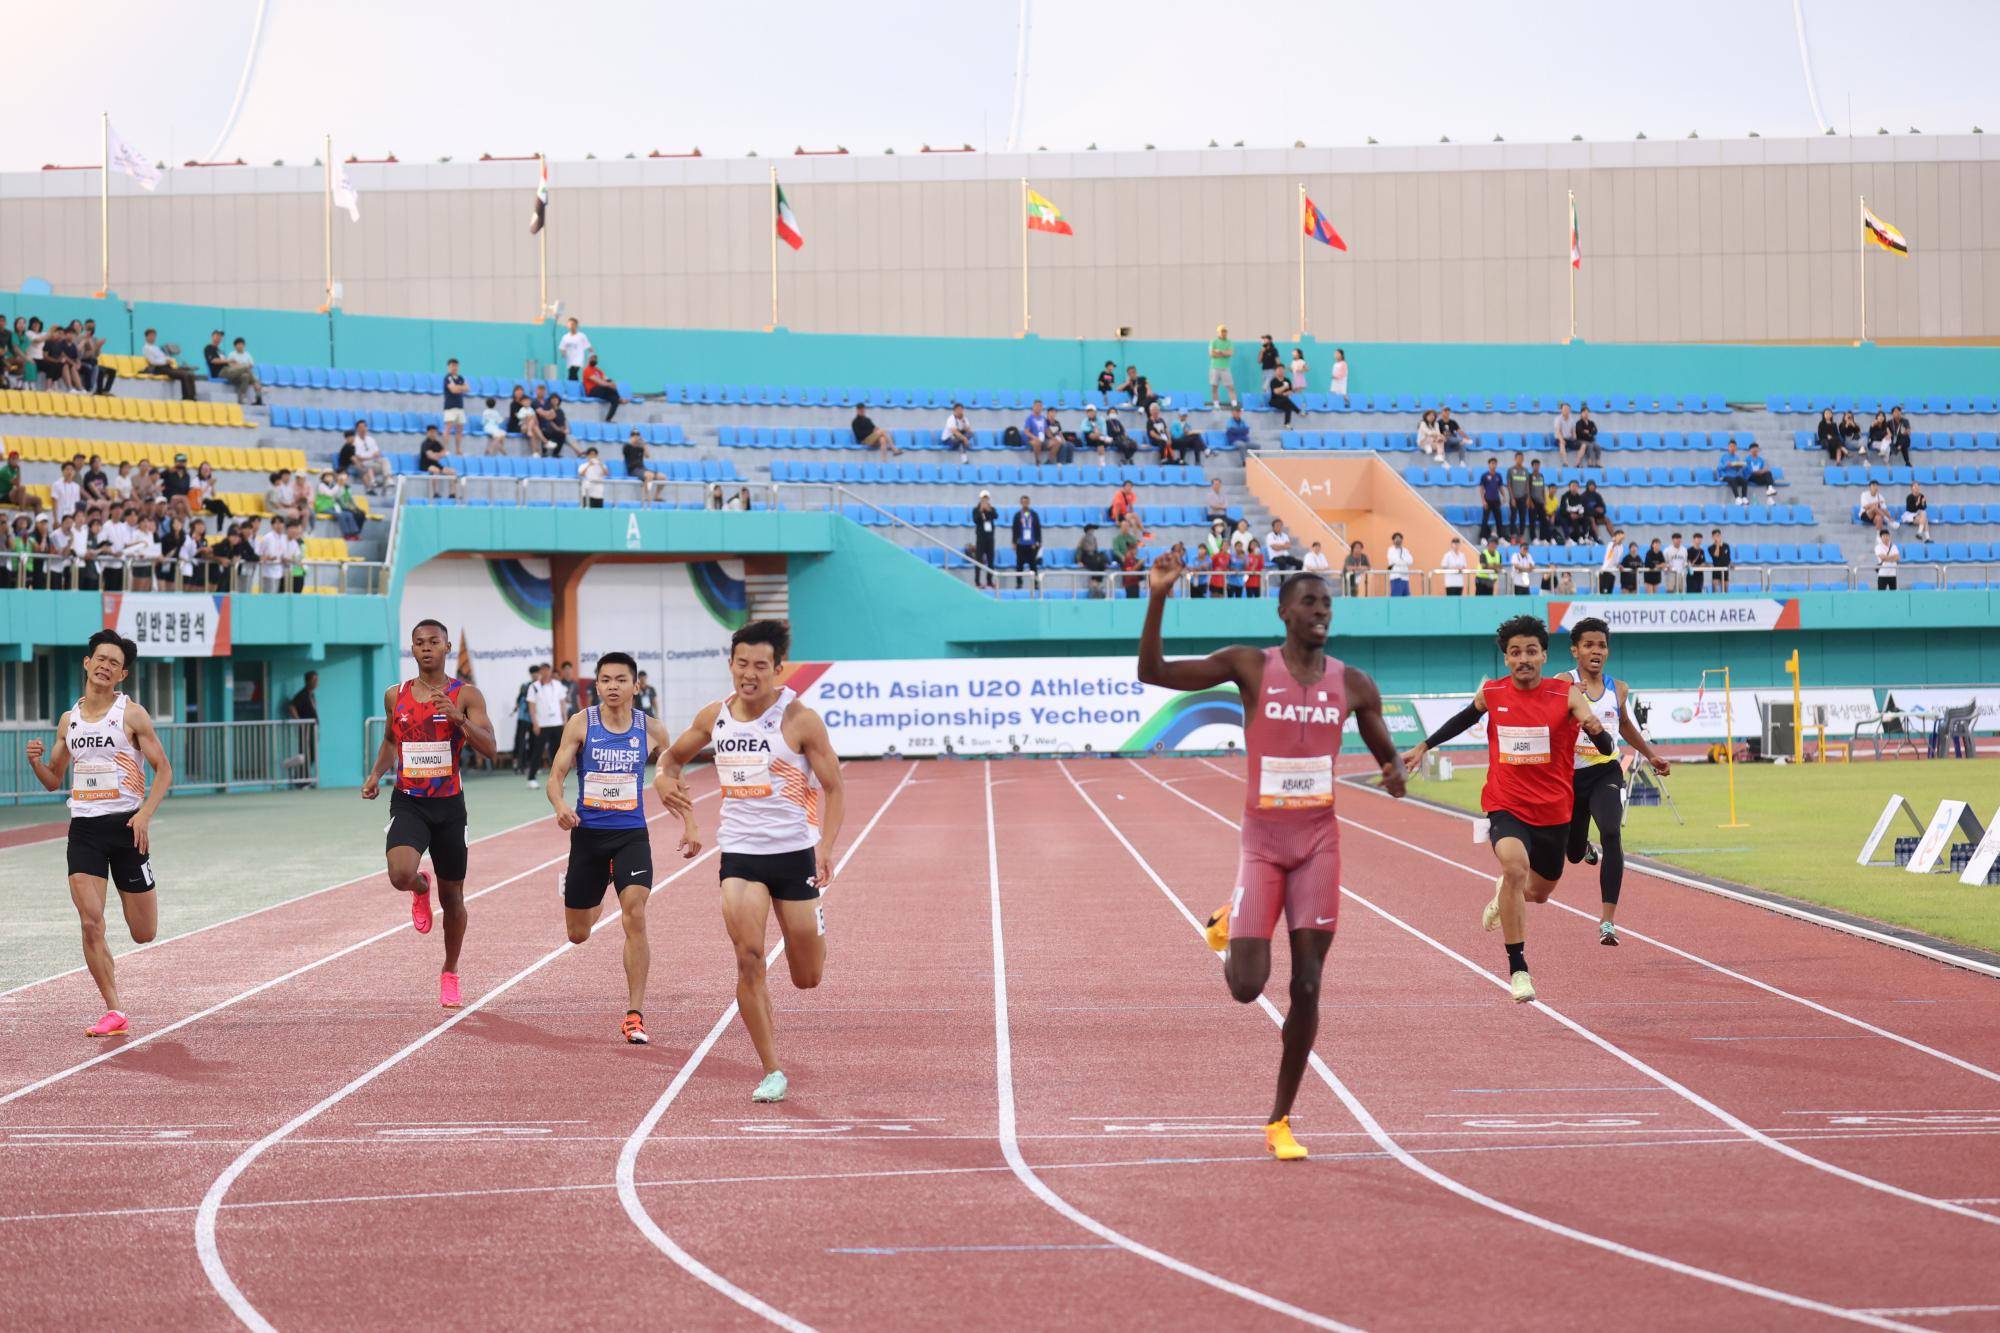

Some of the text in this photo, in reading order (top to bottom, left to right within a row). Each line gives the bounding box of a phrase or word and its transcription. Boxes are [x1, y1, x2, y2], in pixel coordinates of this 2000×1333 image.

[1299, 478, 1331, 496] A-1
[626, 512, 641, 539] A
[1603, 609, 1667, 624] SHOTPUT
[1670, 609, 1716, 624] COACH
[1720, 608, 1756, 623] AREA
[136, 611, 205, 643] 일반관람석
[820, 678, 1145, 699] 20th Asian U20 Athletics
[824, 707, 1141, 731] Championships Yecheon
[1265, 701, 1340, 725] QATAR
[71, 736, 115, 750] KOREA
[717, 739, 771, 753] KOREA
[411, 755, 442, 764] YUYAMADU
[592, 747, 640, 763] CHINESE
[598, 760, 634, 773] TAIPEI
[86, 778, 98, 788] KIM
[602, 787, 620, 797] CHEN
